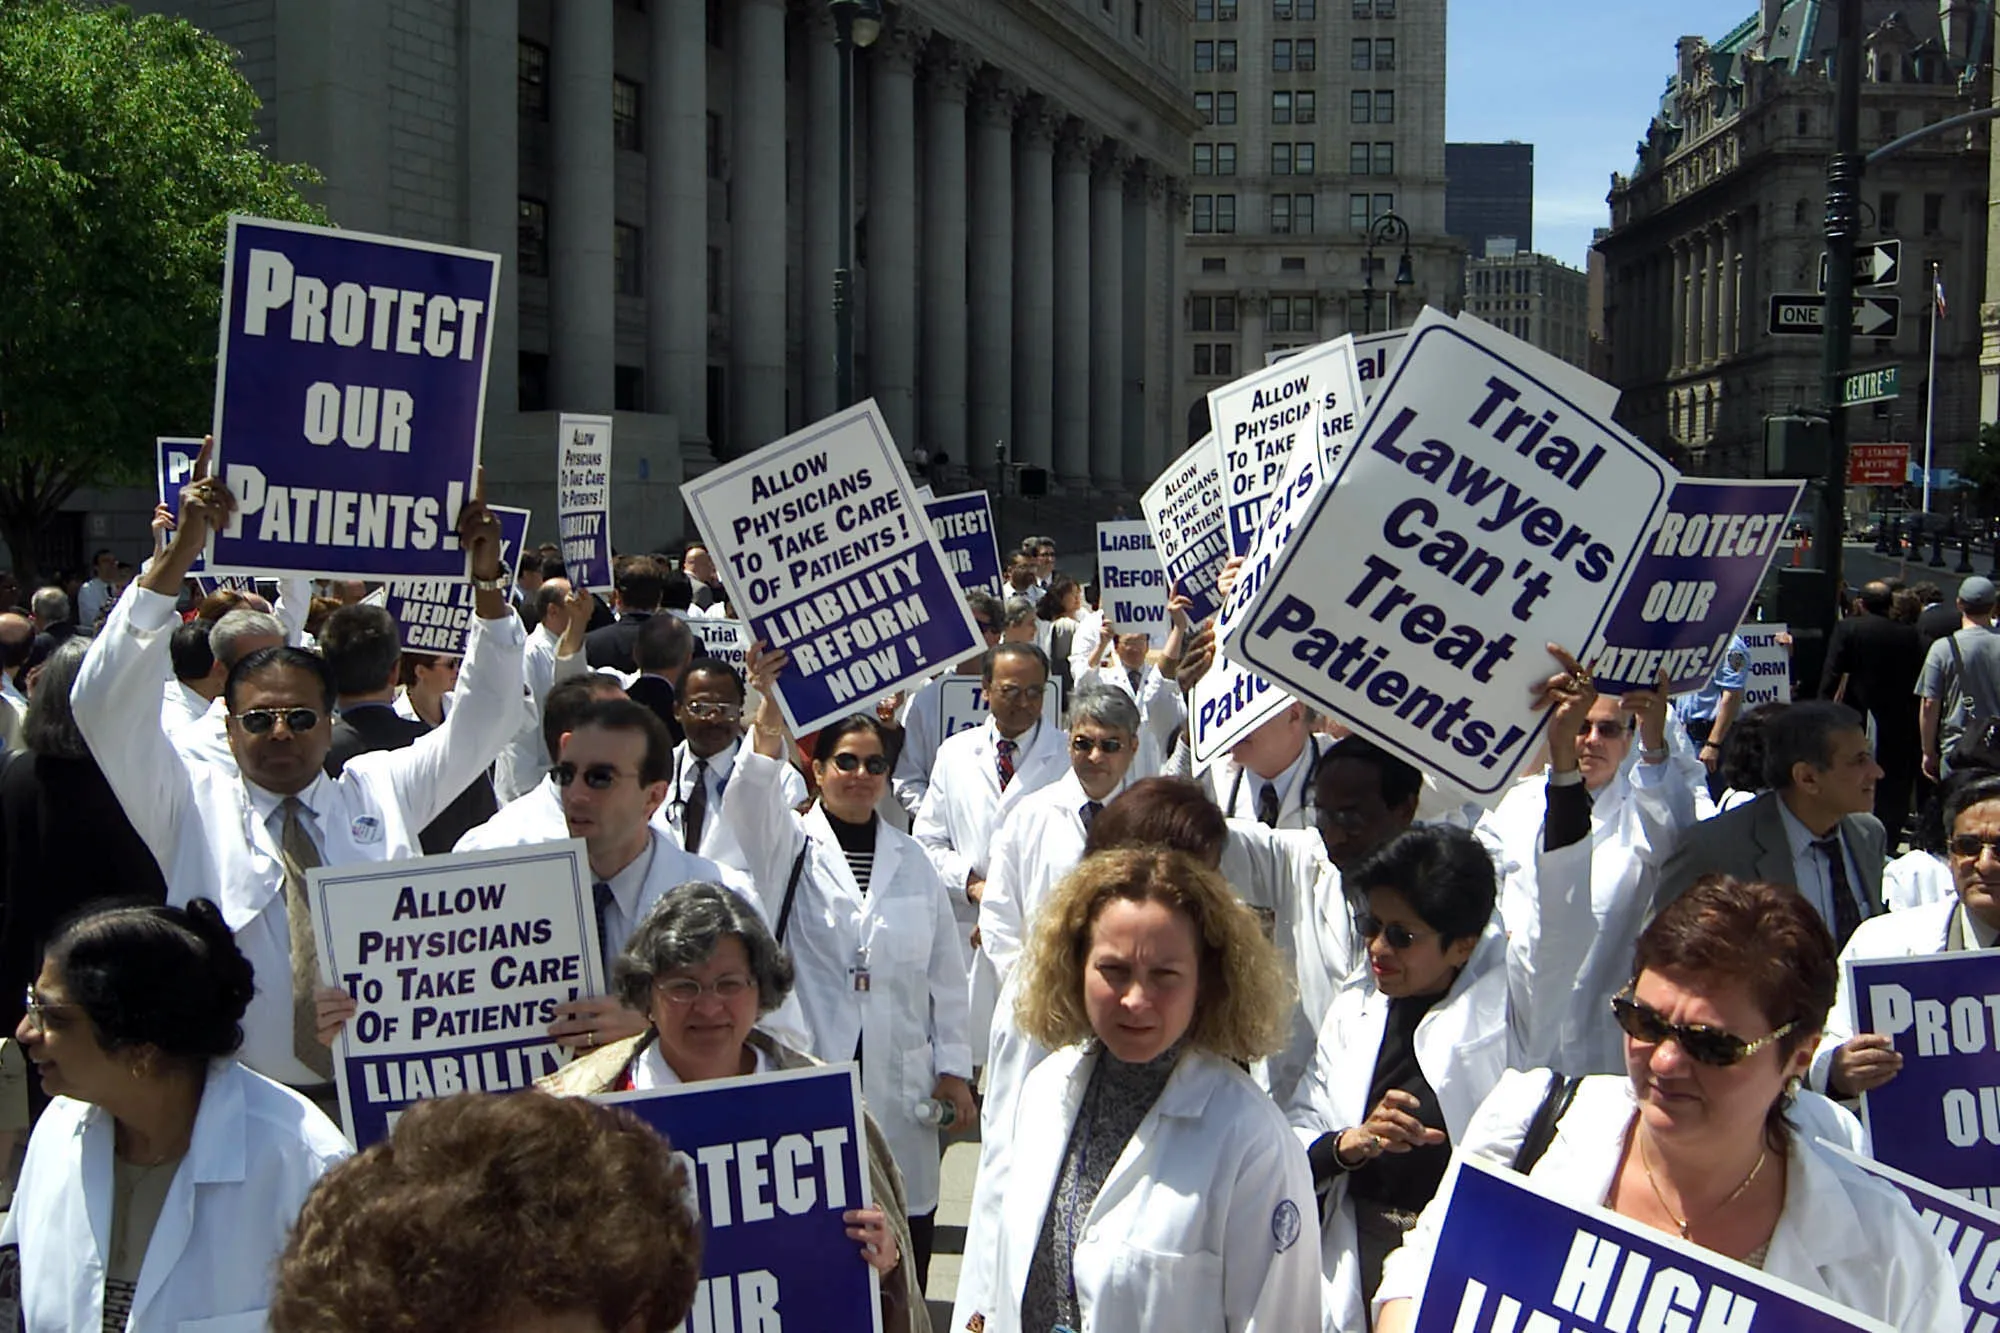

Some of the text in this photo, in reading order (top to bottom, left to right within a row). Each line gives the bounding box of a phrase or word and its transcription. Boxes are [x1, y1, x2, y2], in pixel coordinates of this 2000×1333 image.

[243, 248, 484, 361] PROTECT
[1783, 307, 1818, 323] ONE
[1251, 375, 1310, 413] ALLOW
[1846, 368, 1895, 401] CENTRE ST
[303, 381, 413, 453] OUR
[1468, 376, 1607, 490] Trial
[1227, 451, 1247, 473] TO
[1255, 433, 1295, 462] TAKE
[750, 451, 829, 505] ALLOW
[1158, 468, 1219, 525] PHYSICIANS
[1164, 463, 1198, 500] ALLOW
[1202, 486, 1222, 507] CA
[1371, 406, 1616, 584] Lawyers
[731, 468, 873, 546] PHYSICIANS
[932, 509, 989, 541] OTECT
[1181, 505, 1224, 544] PATIENT
[729, 489, 903, 580] TO TAKE CARE
[1100, 531, 1157, 552] LIABIL
[1652, 512, 1785, 557] ROTECT
[947, 548, 973, 575] UR
[1103, 565, 1164, 589] REFOR
[1383, 497, 1554, 622] Can't
[392, 581, 452, 605] MEAN
[749, 575, 782, 606] OF
[763, 552, 922, 649] LIABILITY
[1115, 600, 1165, 624] NOW
[1640, 580, 1718, 622] OUR
[407, 624, 462, 650] CARE
[700, 626, 738, 642] Trial
[791, 594, 930, 678] REFORM
[1344, 554, 1517, 684] Treat
[1591, 632, 1730, 685] ATIENTS!
[1255, 594, 1526, 770] Patients!
[392, 882, 507, 922] ALLOW
[357, 918, 553, 966] PHYSICIANS
[343, 954, 581, 1003] TO TAKE CARE
[356, 1010, 399, 1044] OF
[1942, 1087, 2000, 1147] OU
[690, 1269, 783, 1333] UR
